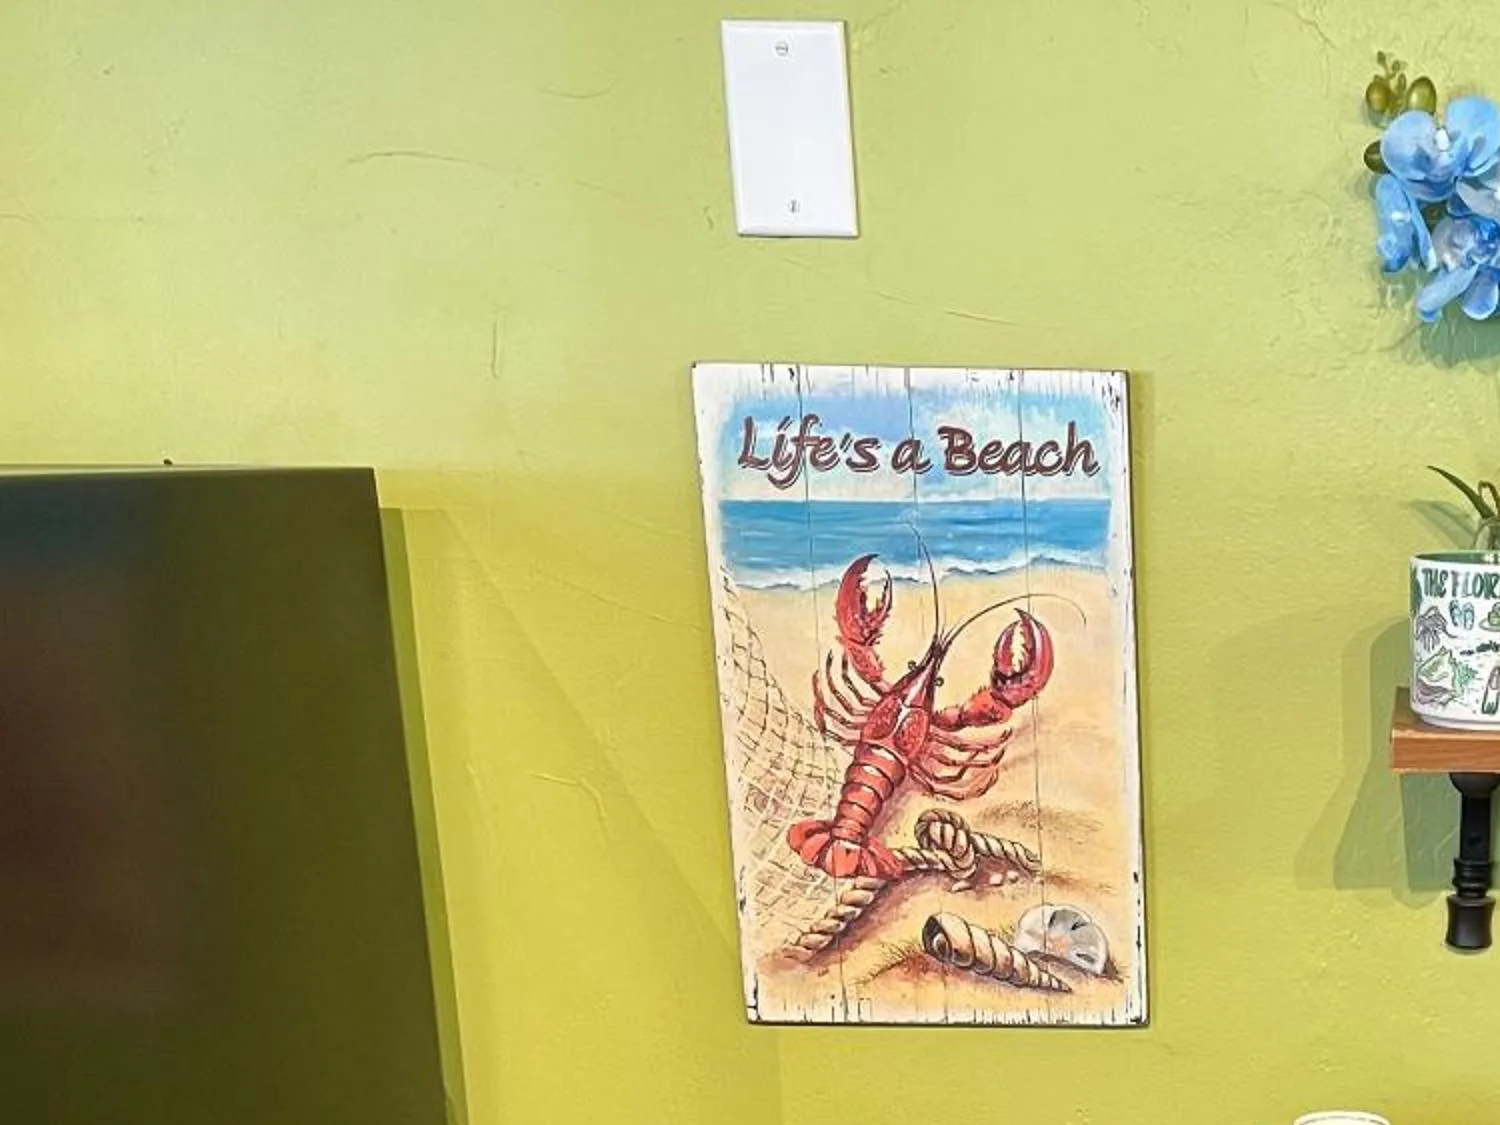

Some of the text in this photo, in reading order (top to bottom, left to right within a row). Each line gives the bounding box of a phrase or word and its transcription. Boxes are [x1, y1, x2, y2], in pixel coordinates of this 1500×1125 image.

[737, 413, 1101, 489] Life's a Beach
[1422, 568, 1448, 598] THE
